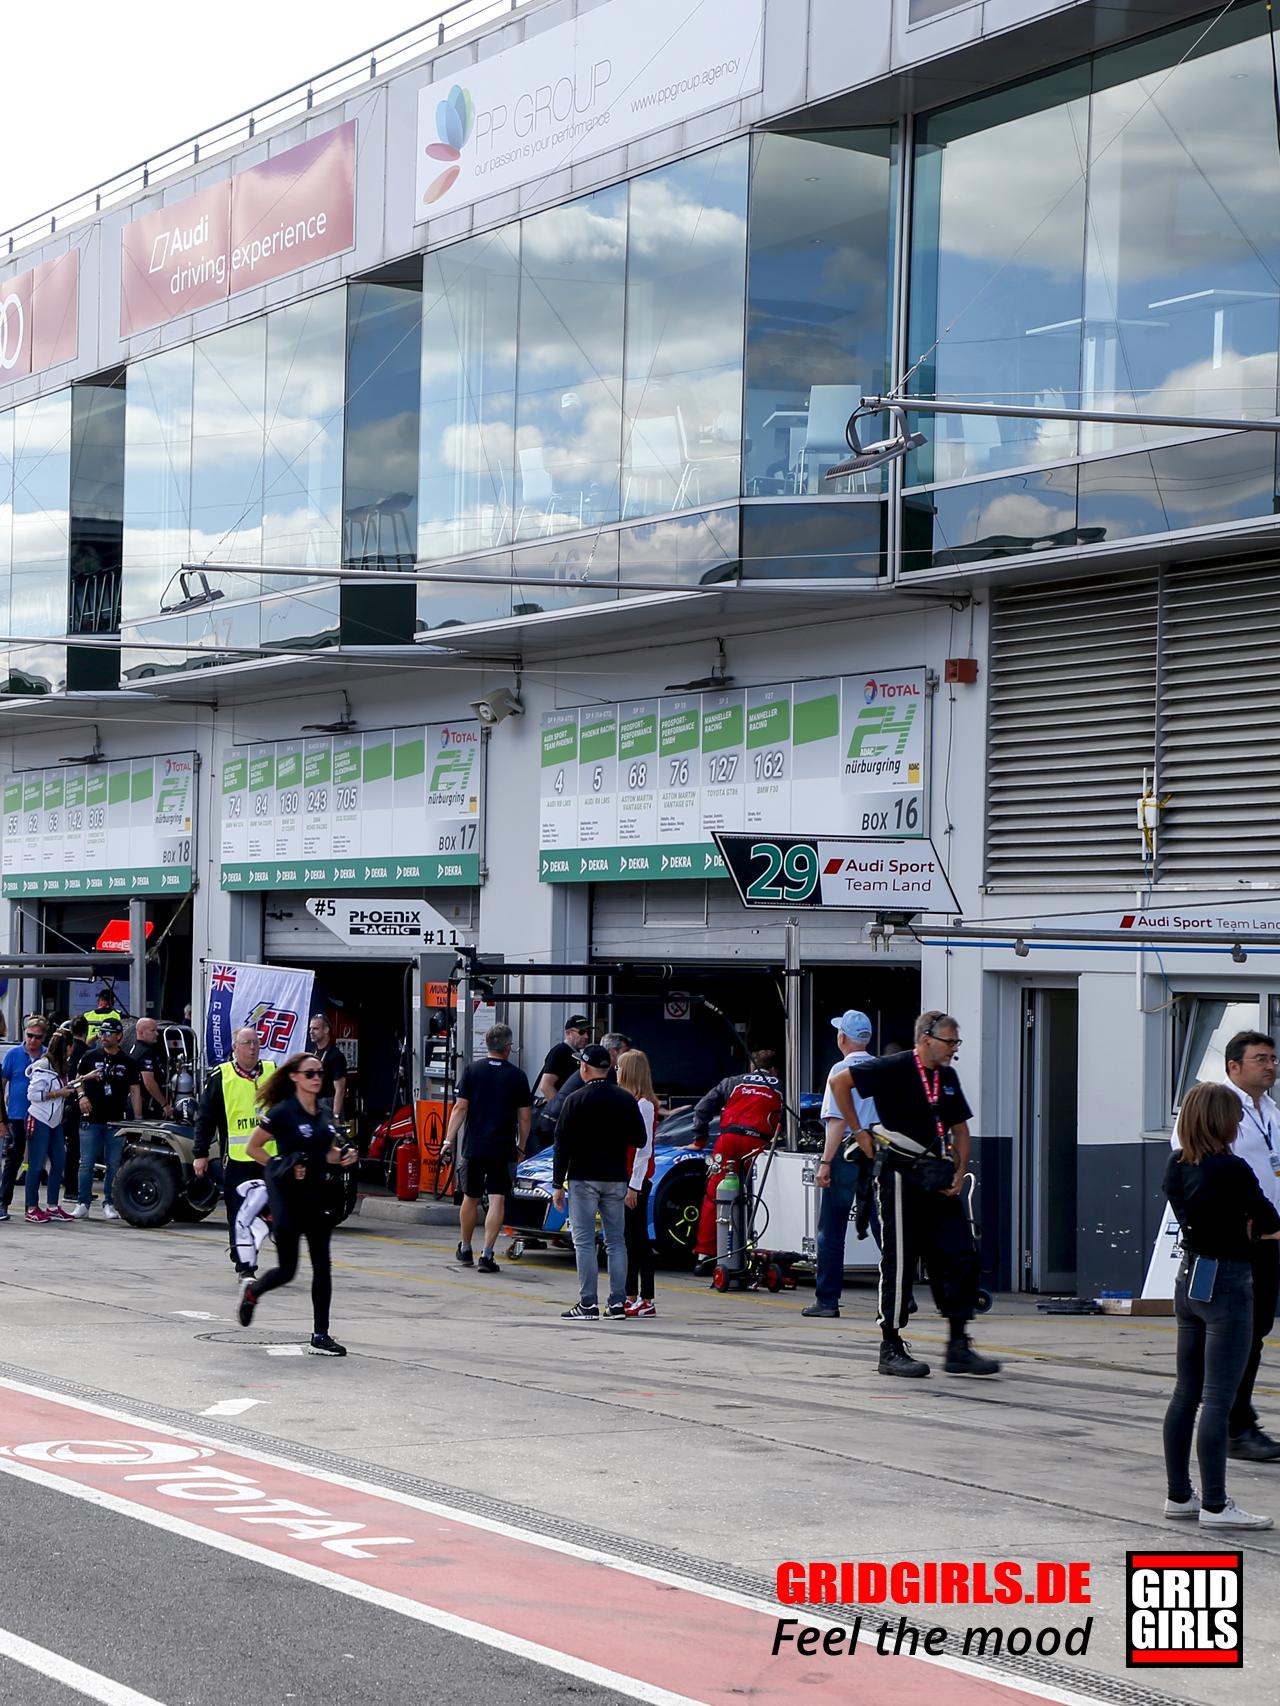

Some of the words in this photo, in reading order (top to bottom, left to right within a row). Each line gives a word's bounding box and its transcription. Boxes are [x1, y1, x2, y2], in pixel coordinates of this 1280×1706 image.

[630, 56, 741, 114] www.ppgroup.agency
[475, 104, 508, 156] PP
[513, 59, 612, 138] GROUP
[489, 148, 523, 174] passion
[550, 111, 611, 149] performance
[169, 214, 210, 257] Audi
[170, 247, 227, 294] driving
[231, 212, 327, 279] experience
[880, 683, 920, 698] TOTAL
[704, 722, 723, 734] RACING
[749, 719, 768, 731] RACING
[450, 731, 478, 744] TOTAL
[628, 762, 647, 789] 68
[670, 759, 689, 785] 76
[709, 755, 738, 783] 127
[753, 751, 784, 779] 162
[845, 757, 901, 775] nürburgring
[554, 769, 564, 794] 4
[593, 766, 603, 792] 5
[228, 797, 241, 818] 74
[255, 795, 268, 816] 84
[279, 791, 299, 814] 130
[306, 789, 328, 813] 243
[336, 786, 358, 811] 705
[427, 792, 466, 806] nürburgring
[89, 808, 104, 829] 303
[861, 812, 889, 831] BOX
[894, 796, 918, 830] 16
[438, 836, 457, 851] BOX
[460, 823, 477, 850] 17
[162, 850, 176, 863] BOX
[178, 839, 190, 862] 18
[340, 868, 356, 880] DEKRA
[371, 867, 388, 879] DEKRA
[403, 866, 420, 877] DEKRA
[444, 866, 462, 877] DEKRA
[550, 860, 570, 872] DEKRA
[588, 859, 609, 871] DEKRA
[624, 857, 650, 870] DEKRA
[670, 855, 692, 868] DEKRA
[746, 842, 820, 902] 29
[845, 859, 884, 872] Audi
[888, 859, 935, 875] Sport
[226, 872, 242, 883] DEKRA
[254, 871, 269, 882] DEKRA
[282, 870, 297, 881] DEKRA
[310, 869, 326, 880] DEKRA
[844, 878, 888, 892] Team
[892, 878, 932, 892] Land
[314, 898, 337, 917] #5
[1137, 916, 1169, 927] Audi
[1173, 916, 1213, 930] Sport
[1216, 918, 1250, 929] Team
[423, 929, 459, 946] #11
[237, 1118, 248, 1130] PIT
[123, 1465, 416, 1559] TOTAL
